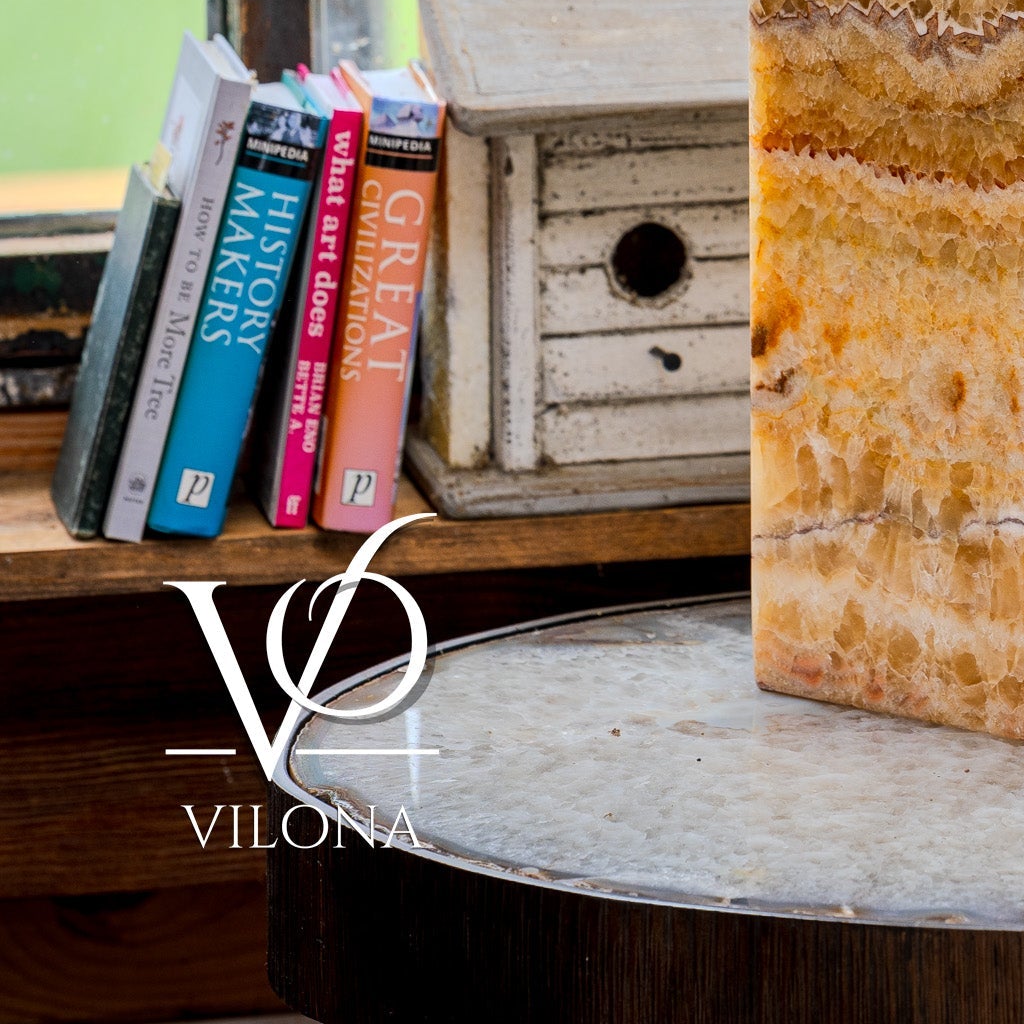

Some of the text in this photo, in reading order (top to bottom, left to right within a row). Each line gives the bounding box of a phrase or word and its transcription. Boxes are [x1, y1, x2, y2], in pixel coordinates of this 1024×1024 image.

[246, 137, 309, 163] MINIPEDIA
[369, 134, 432, 153] MINIPEDIA
[144, 196, 215, 421] HOW TO BE More Tree
[200, 181, 266, 346] MAKERS
[237, 191, 300, 355] HISTORY
[307, 130, 355, 338] what art does
[339, 179, 383, 382] CIVILIZATIONS
[366, 189, 426, 382] GREAT
[291, 360, 311, 415] BETTE
[302, 361, 327, 453] BRIAN ENO
